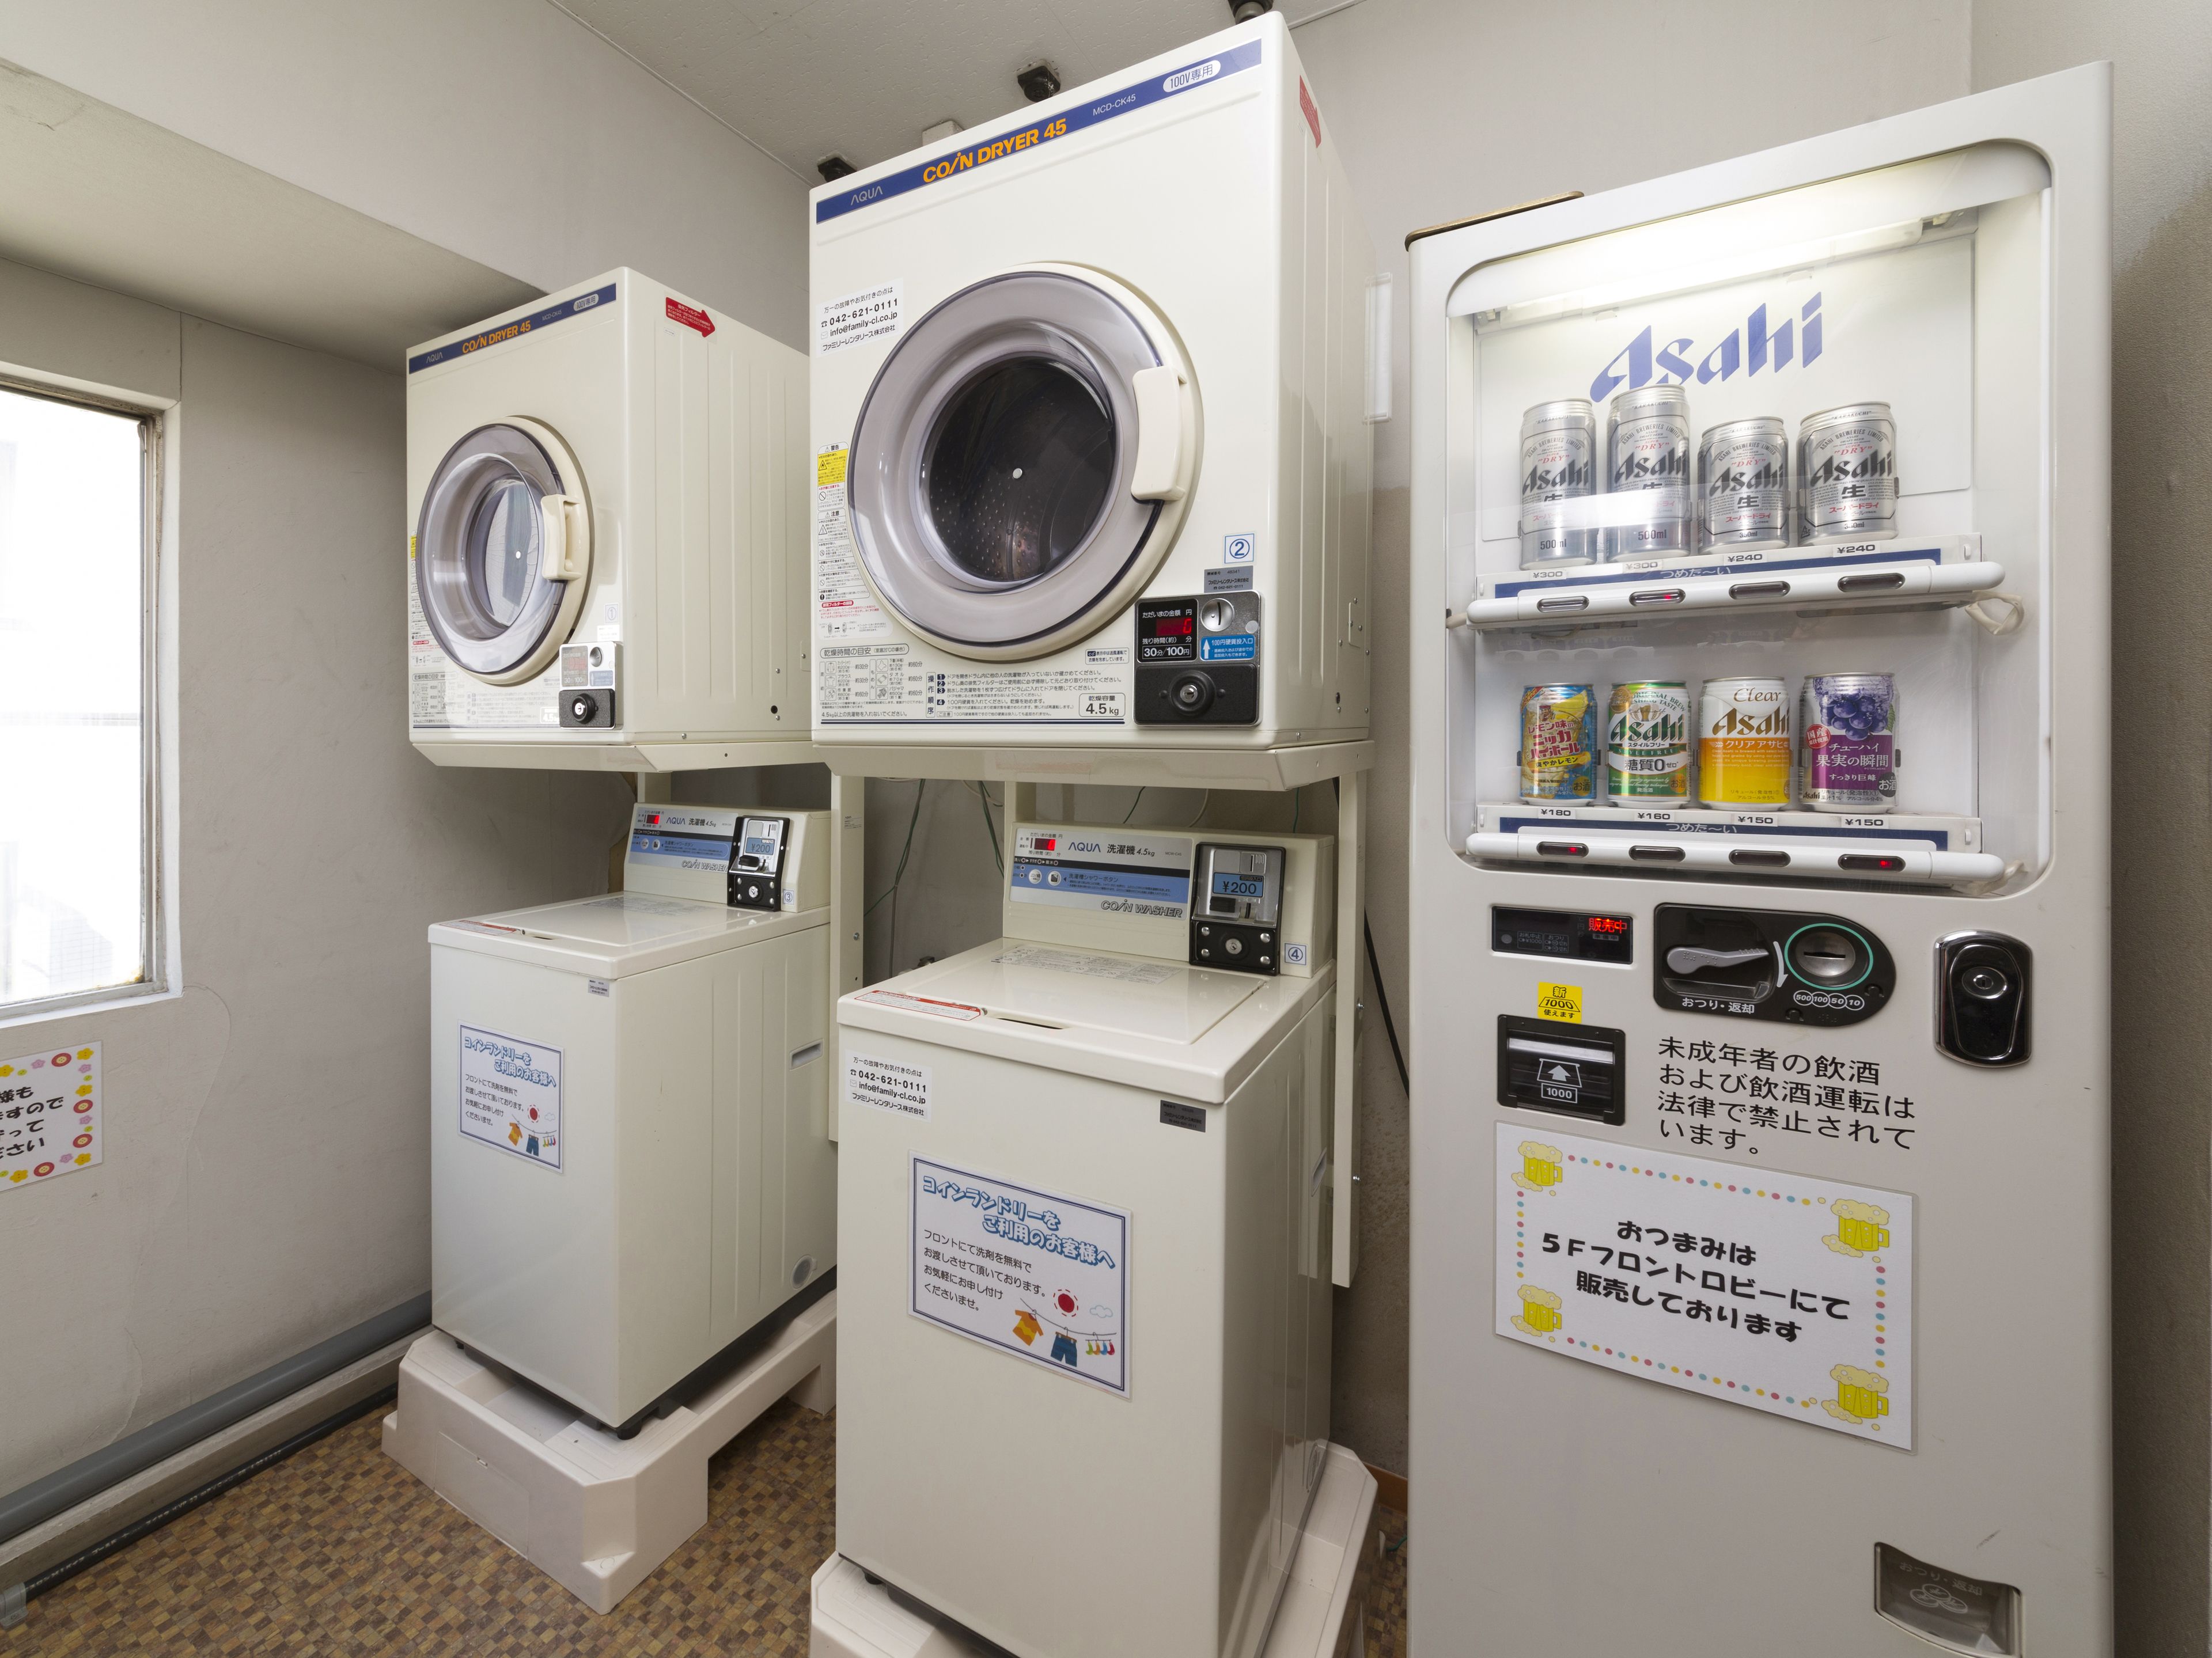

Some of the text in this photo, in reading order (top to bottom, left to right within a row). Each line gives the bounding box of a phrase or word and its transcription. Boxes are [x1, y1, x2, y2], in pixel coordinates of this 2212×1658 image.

[851, 64, 1213, 206] AQUA COIN DRYER 45 MCD-CK45 100V専用
[824, 287, 893, 314] 万一の故障やお気付きの点は
[830, 298, 897, 325] 042-621-0111
[426, 352, 443, 363] AQUA
[488, 325, 518, 344] DRYER
[520, 321, 531, 332] 45
[542, 309, 562, 321] MCD-CK45
[576, 295, 596, 310] 100V専用
[830, 312, 897, 336] info@family-cl.co.jp
[823, 325, 895, 351] ファミリーレンタリース株式会社
[1590, 291, 1823, 403] Asahi
[1636, 424, 1664, 434] BREWERIES
[1666, 425, 1680, 438] LIMITED
[1835, 429, 1866, 439] BREWERIES
[1868, 430, 1884, 442] LIMITED
[1539, 437, 1565, 448] BREWERIES
[1566, 438, 1581, 450] LIMITED
[1732, 442, 1759, 452] BREWERIES
[1762, 443, 1777, 455] LIMITED
[1615, 447, 1687, 484] Asahi
[1810, 449, 1892, 487] Asahi
[1522, 459, 1589, 495] Asahi
[1709, 461, 1783, 497] Asahi
[1842, 484, 1866, 499] 生
[1737, 495, 1760, 509] 生
[1638, 529, 1666, 541] 500ml
[1837, 544, 1875, 554] ¥240
[1625, 561, 1658, 570] ¥300
[1728, 553, 1763, 563] ¥240
[1142, 610, 1181, 618] ただいまの金額
[1183, 618, 1192, 633] 0
[824, 647, 871, 657] 乾燥時間の目安
[1144, 646, 1190, 657] 30分/100円
[927, 675, 935, 715] 操作順序
[1733, 687, 1781, 702] Clear
[1086, 703, 1119, 715] 4.5 kg
[1660, 700, 1677, 711] TASTE
[1670, 697, 1685, 712] BREW
[1528, 720, 1574, 734] レモン味の
[1611, 714, 1685, 742] Asahi
[1712, 706, 1790, 736] Asahi
[1533, 730, 1571, 747] ニッカ
[1808, 728, 1827, 740] 国産
[1531, 742, 1581, 760] ハイボール
[1829, 743, 1880, 752] チューハイ
[1536, 757, 1578, 768] 爽やかレモン
[1624, 758, 1665, 772] 糖質0
[1816, 754, 1889, 767] 果実の瞬間
[1573, 782, 1590, 792] お酒
[1671, 779, 1685, 788] お酒
[1878, 780, 1896, 791] お酒
[666, 817, 685, 825] AQUA
[688, 818, 705, 826] 洗濯機
[751, 843, 770, 852] ¥200
[1069, 842, 1155, 857] AQUA 洗濯機 4.5kg
[1069, 873, 1119, 883] 洗濯槽シャワーボタン
[1222, 881, 1257, 894] ¥200
[1101, 898, 1183, 918] COIN WASHER
[1589, 917, 1627, 934] 販売中
[1552, 986, 1567, 999] 新
[1796, 993, 1812, 1001] 500
[1545, 999, 1574, 1010] 1000
[1682, 997, 1755, 1014] おつり・返却
[1544, 1009, 1575, 1019] 使えます
[464, 1036, 532, 1066] コインランドリーを
[853, 1057, 922, 1077] 万一の故障やお気付きの点は
[1658, 1037, 1880, 1086] 未成年者の飲酒
[494, 1058, 556, 1087] ご利用のお客様へ
[859, 1070, 926, 1092] 042-621-0111
[465, 1074, 518, 1097] フロントにて洗剤を無料で
[859, 1082, 926, 1105] info@family-cl.co.jp
[1546, 1087, 1573, 1099] 1000
[1660, 1063, 1915, 1120] および飲酒運転は
[465, 1086, 524, 1111] お渡しさせて頂いております。
[853, 1092, 925, 1116] ファミリーレンタリース株式会社
[0, 1097, 64, 1120] すので
[465, 1098, 504, 1117] お気軽にお申し付け
[465, 1111, 493, 1126] くださいませ。
[1658, 1090, 1916, 1151] 法律で禁止されて
[0, 1119, 44, 1139] って
[1660, 1120, 1759, 1155] います。
[923, 1175, 1061, 1231] コインランドリーを
[982, 1213, 1116, 1269] ご利用のお客様へ
[1618, 1220, 1756, 1266] おつまみは
[924, 1230, 1032, 1273] フロントにて洗剤を無料で
[924, 1247, 1046, 1297] お渡しさせて頂いております。
[1542, 1232, 1850, 1321] 5Fフロントロビーにて
[924, 1265, 1003, 1300] お気軽にお申し付け
[924, 1284, 979, 1311] くださいませ。
[1576, 1269, 1802, 1344] 販売しております
[1900, 1561, 1982, 1596] おつり・返却
